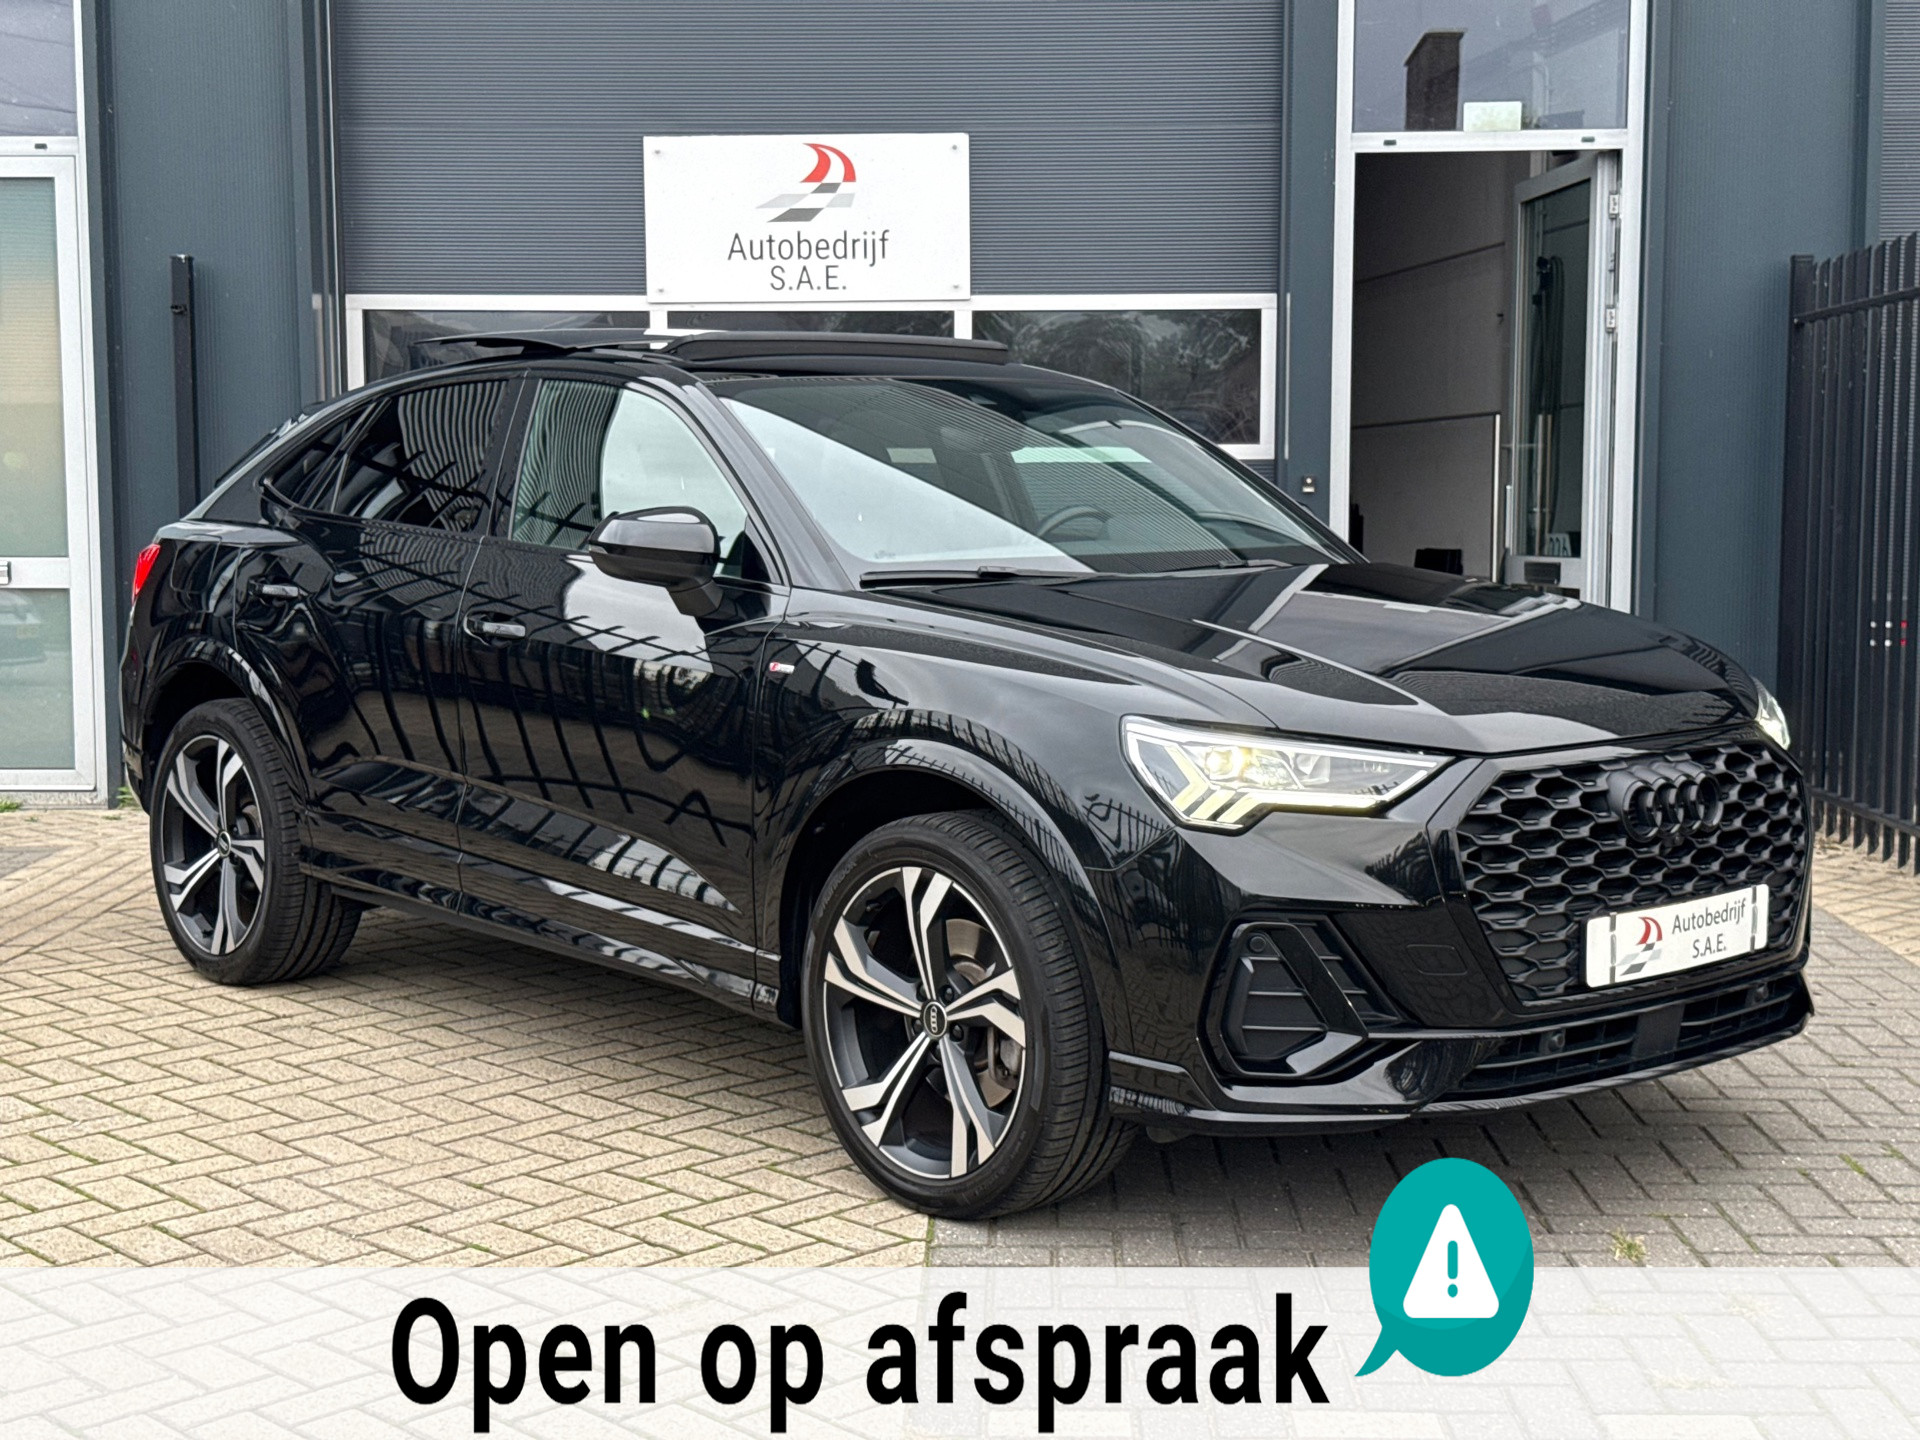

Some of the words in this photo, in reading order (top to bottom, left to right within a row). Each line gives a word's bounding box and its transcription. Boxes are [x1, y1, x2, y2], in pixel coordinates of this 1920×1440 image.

[727, 229, 890, 268] Autobedrijf
[769, 264, 847, 291] S.A.E.
[1671, 897, 1747, 935] Autobedrijf
[1692, 932, 1727, 959] S.A.E.
